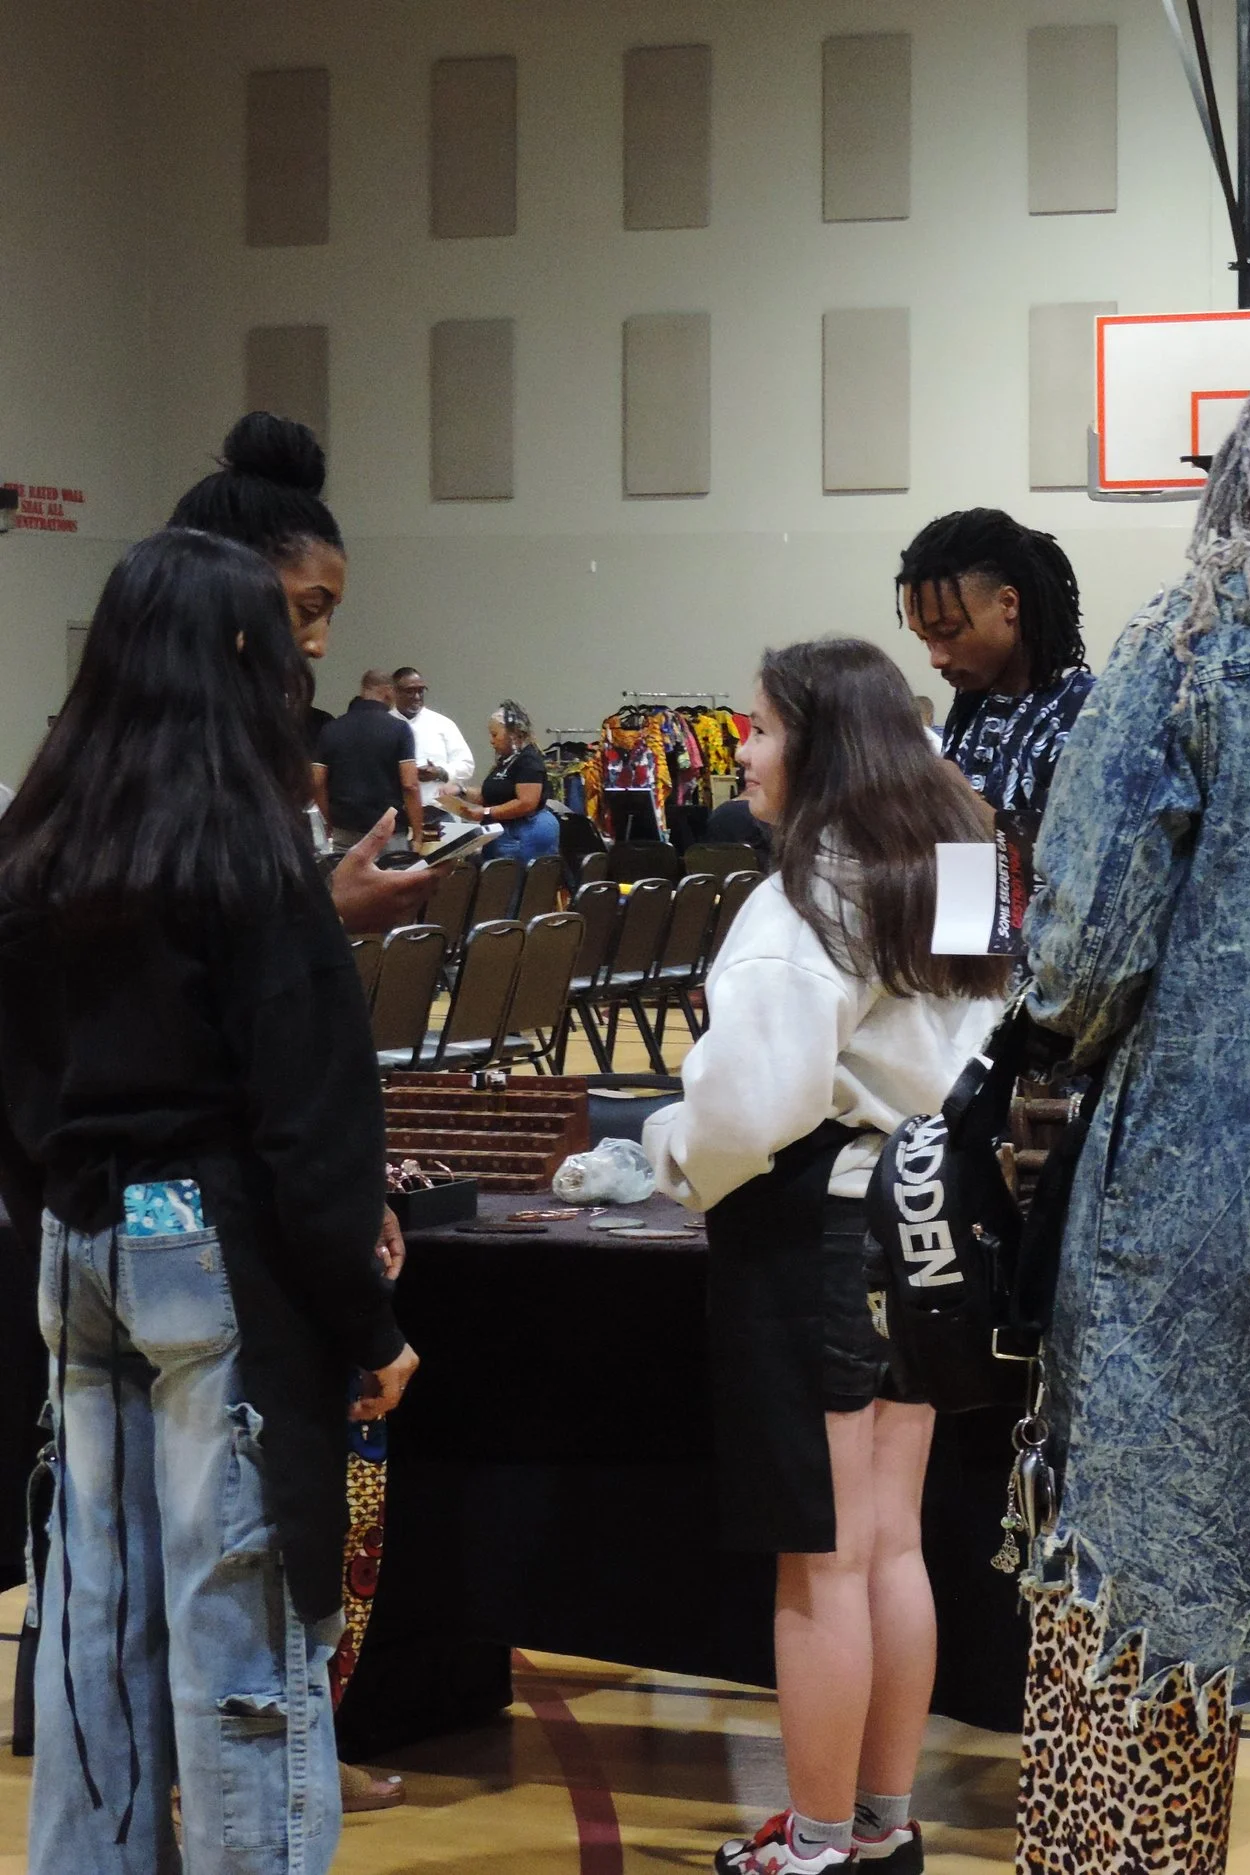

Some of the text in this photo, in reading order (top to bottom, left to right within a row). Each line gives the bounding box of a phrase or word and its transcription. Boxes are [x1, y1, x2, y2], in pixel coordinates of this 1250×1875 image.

[995, 829, 1011, 938] SOME SECRETS CAN
